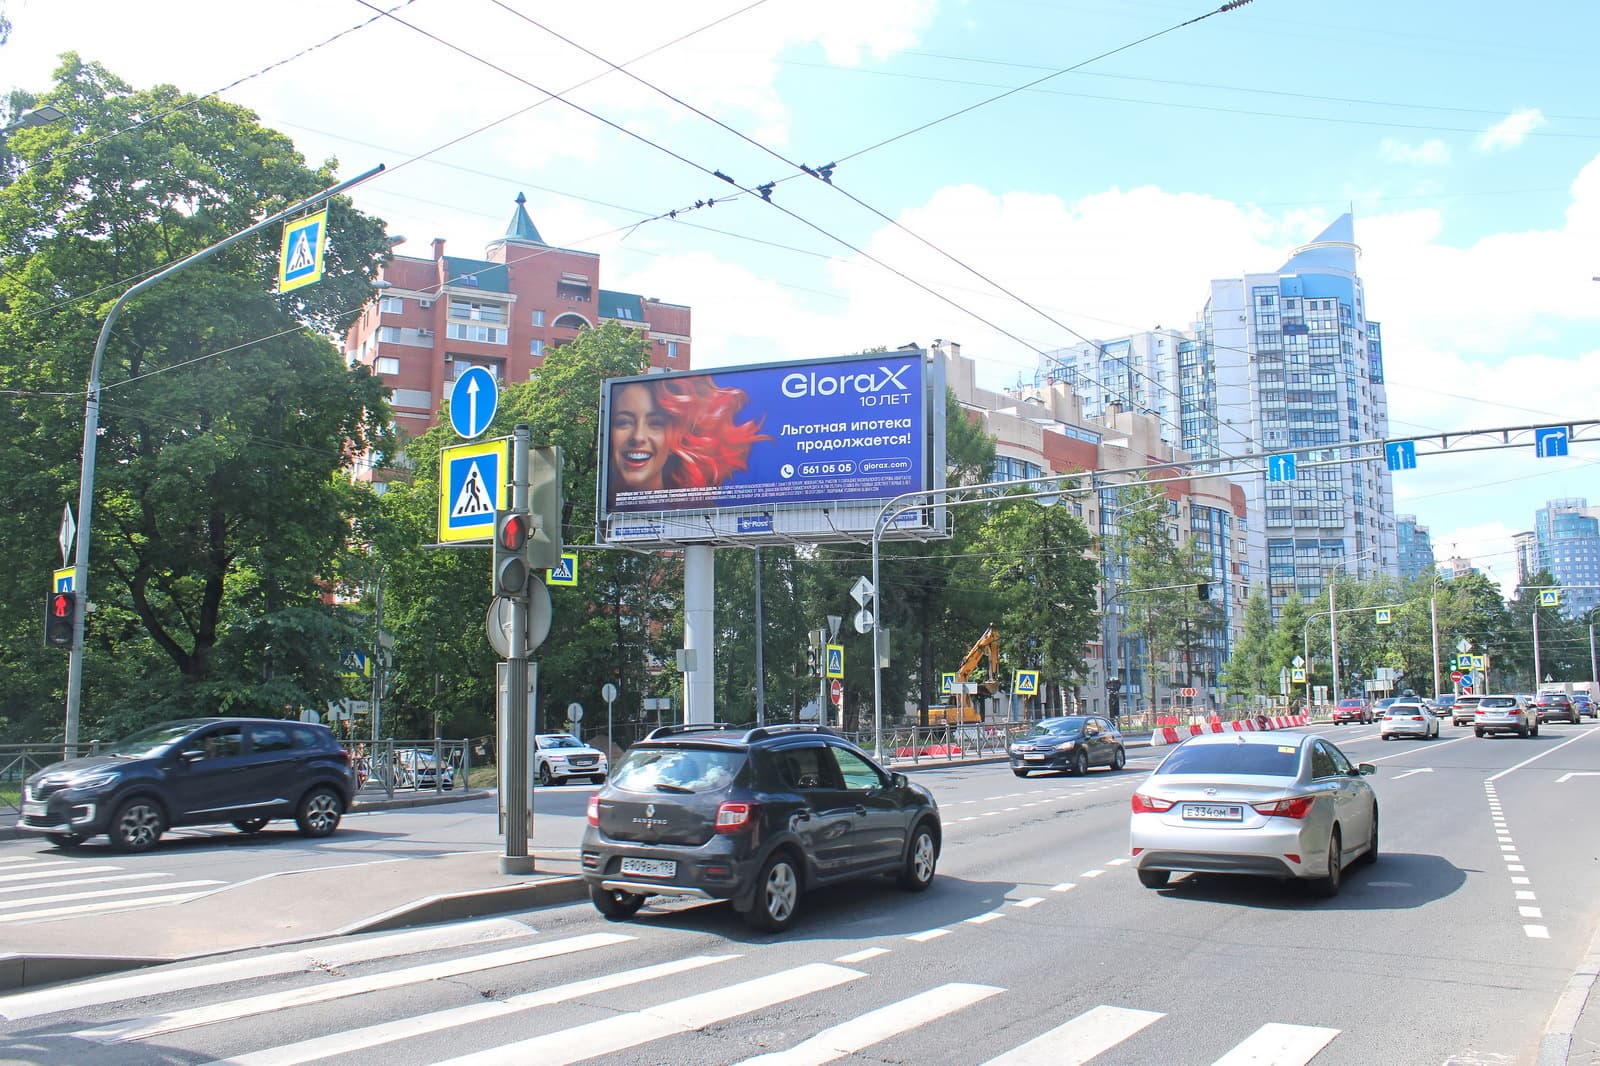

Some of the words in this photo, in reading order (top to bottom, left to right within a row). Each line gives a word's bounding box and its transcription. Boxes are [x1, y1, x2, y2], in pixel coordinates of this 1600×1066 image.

[781, 364, 912, 398] GloraX
[860, 396, 877, 407] 10
[879, 393, 912, 405] ЛЕТ
[780, 422, 847, 435] Льготная
[851, 418, 912, 431] ипотека
[796, 433, 911, 453] продолжается!
[803, 465, 819, 474] 561
[822, 465, 836, 473] 05
[838, 463, 852, 472] 05
[863, 460, 908, 471] glorax.com
